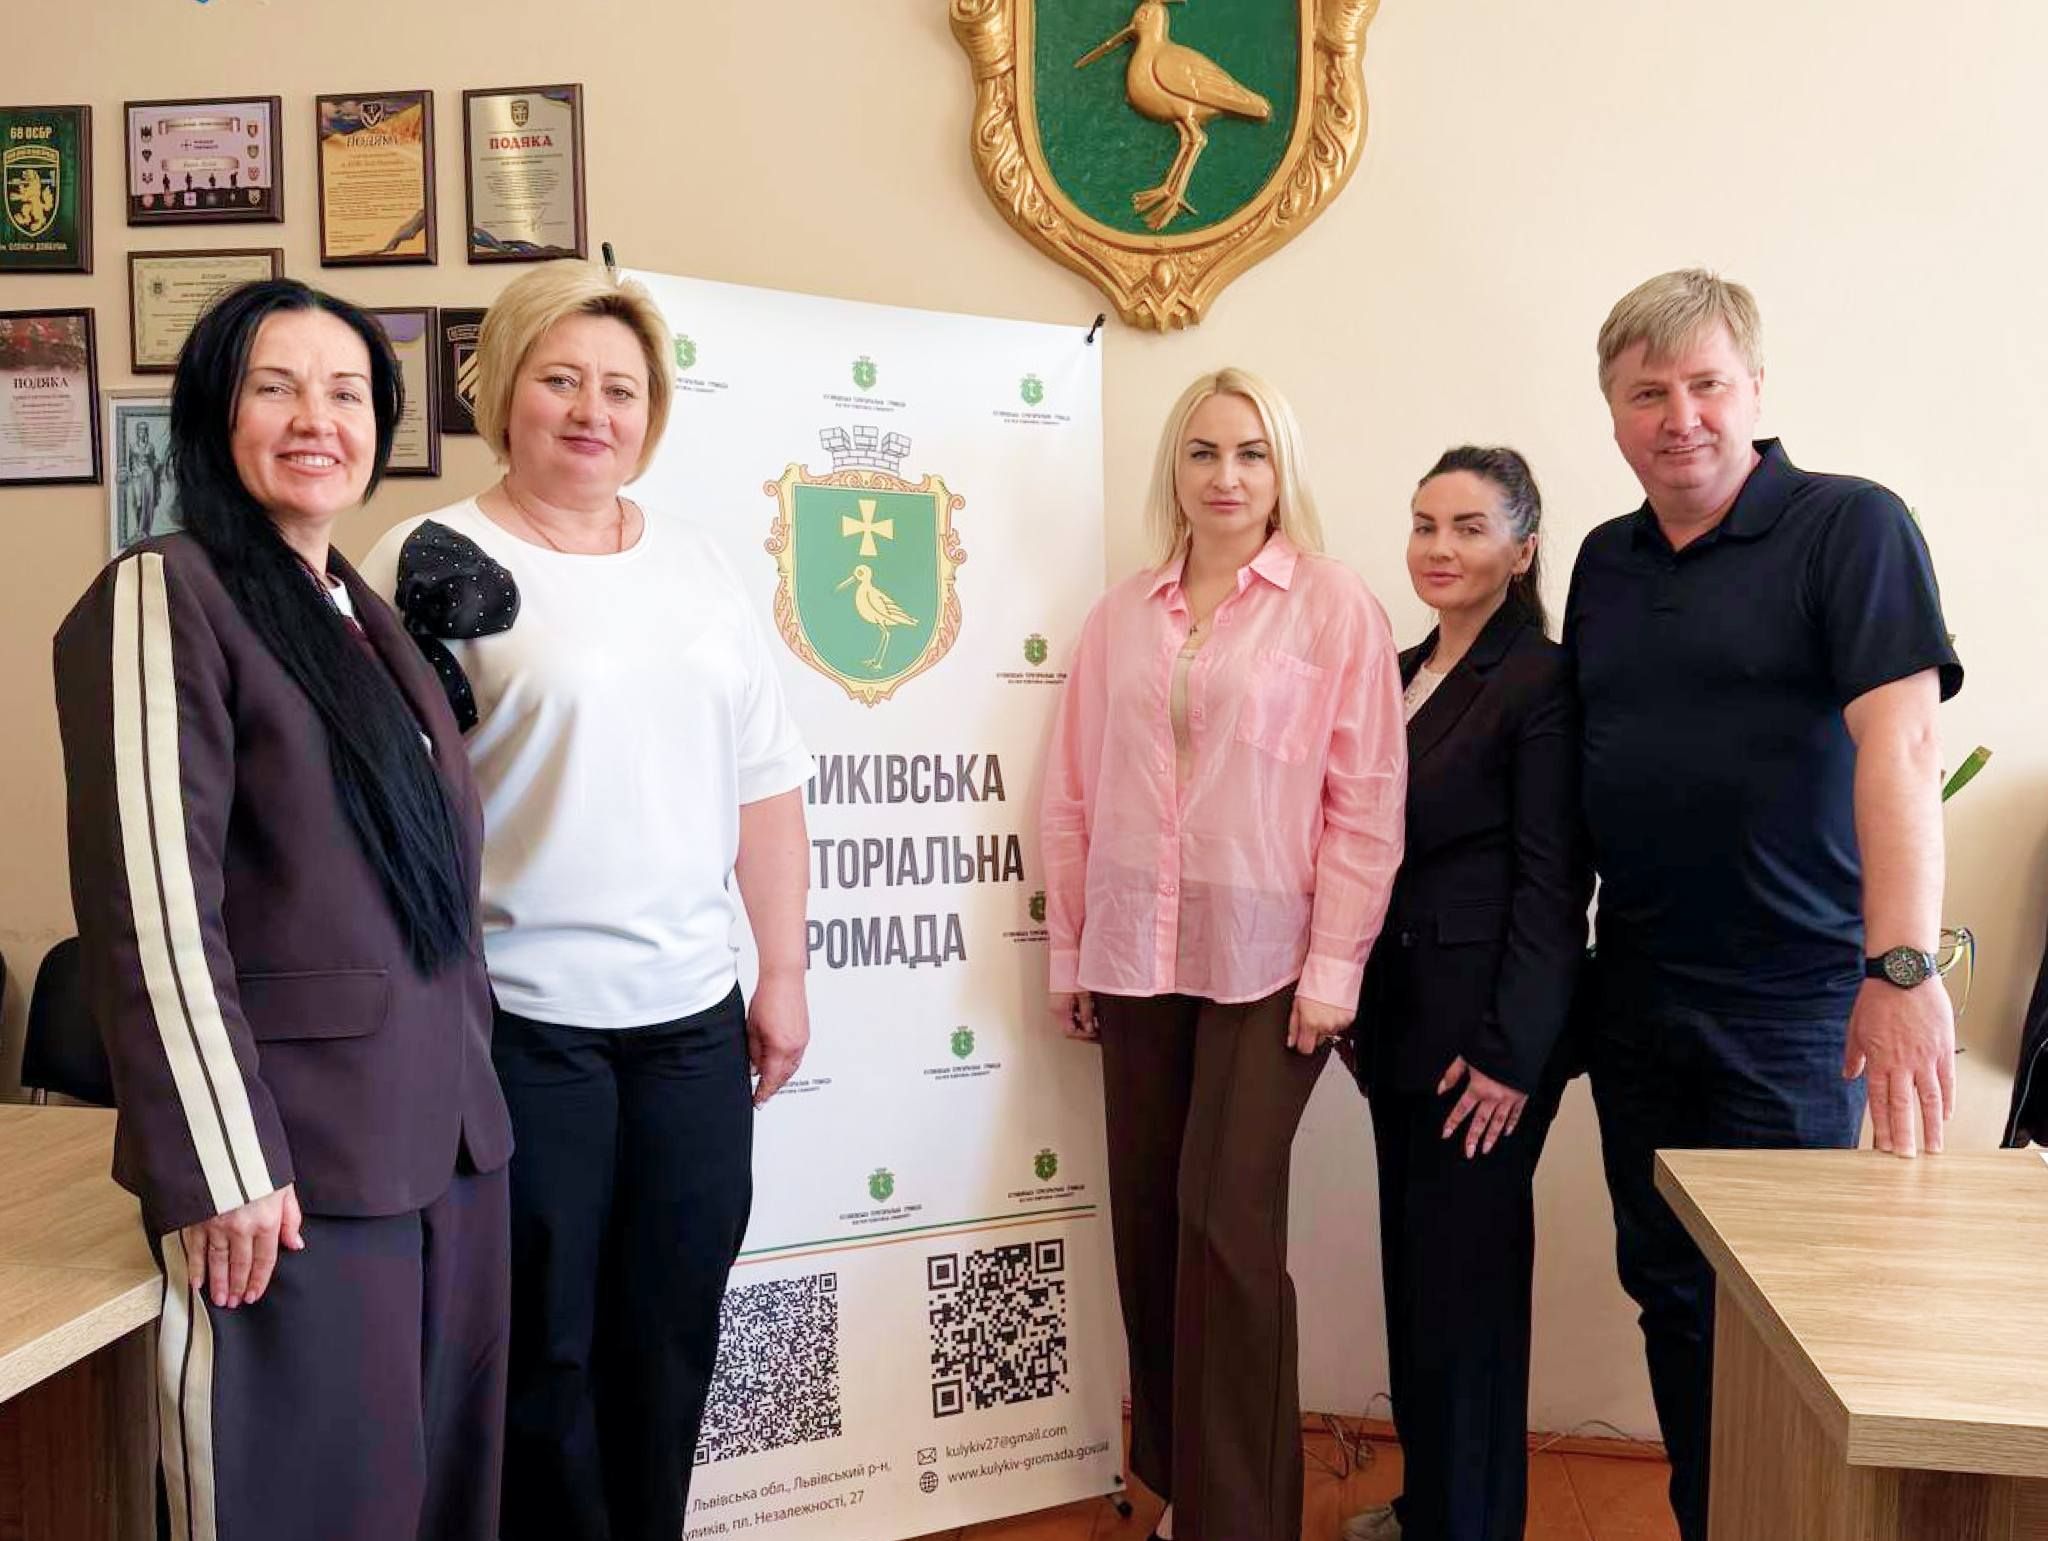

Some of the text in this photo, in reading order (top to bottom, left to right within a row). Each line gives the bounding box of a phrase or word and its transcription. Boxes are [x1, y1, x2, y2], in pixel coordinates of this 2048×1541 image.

[10, 126, 24, 140] 68
[489, 135, 553, 150] ПОДЯКА
[13, 377, 70, 390] ПОДЯКА
[807, 753, 1006, 805] ИКІВСЬКА
[807, 834, 1025, 890] ТОРІАЛЬНА
[945, 1424, 1068, 1459] kulykiv27@gmail.com
[692, 1488, 758, 1513] Львівська
[793, 1463, 865, 1491] Львівський
[754, 1493, 848, 1525] Незалежності,
[849, 1490, 865, 1505] 27
